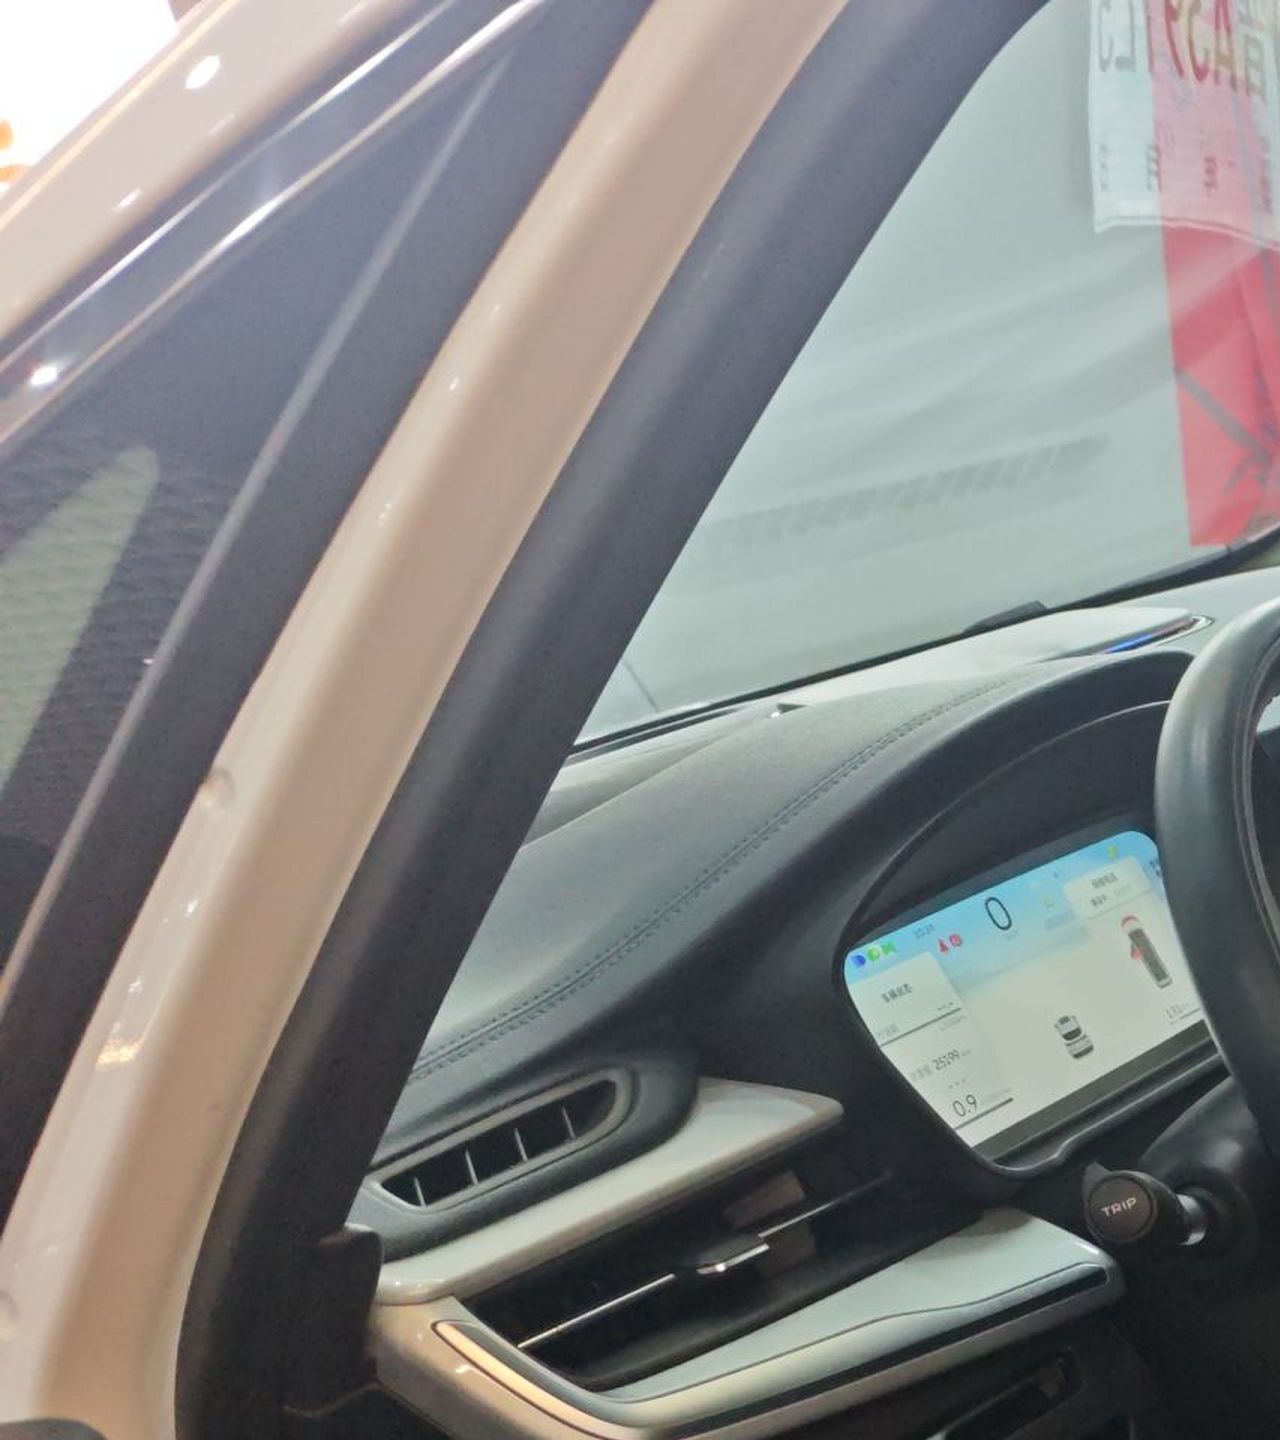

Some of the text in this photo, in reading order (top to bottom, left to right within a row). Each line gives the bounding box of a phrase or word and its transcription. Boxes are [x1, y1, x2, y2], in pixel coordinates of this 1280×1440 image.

[984, 896, 1012, 931] 0
[951, 1094, 978, 1117] 0.9
[1101, 1197, 1138, 1217] TRIP
